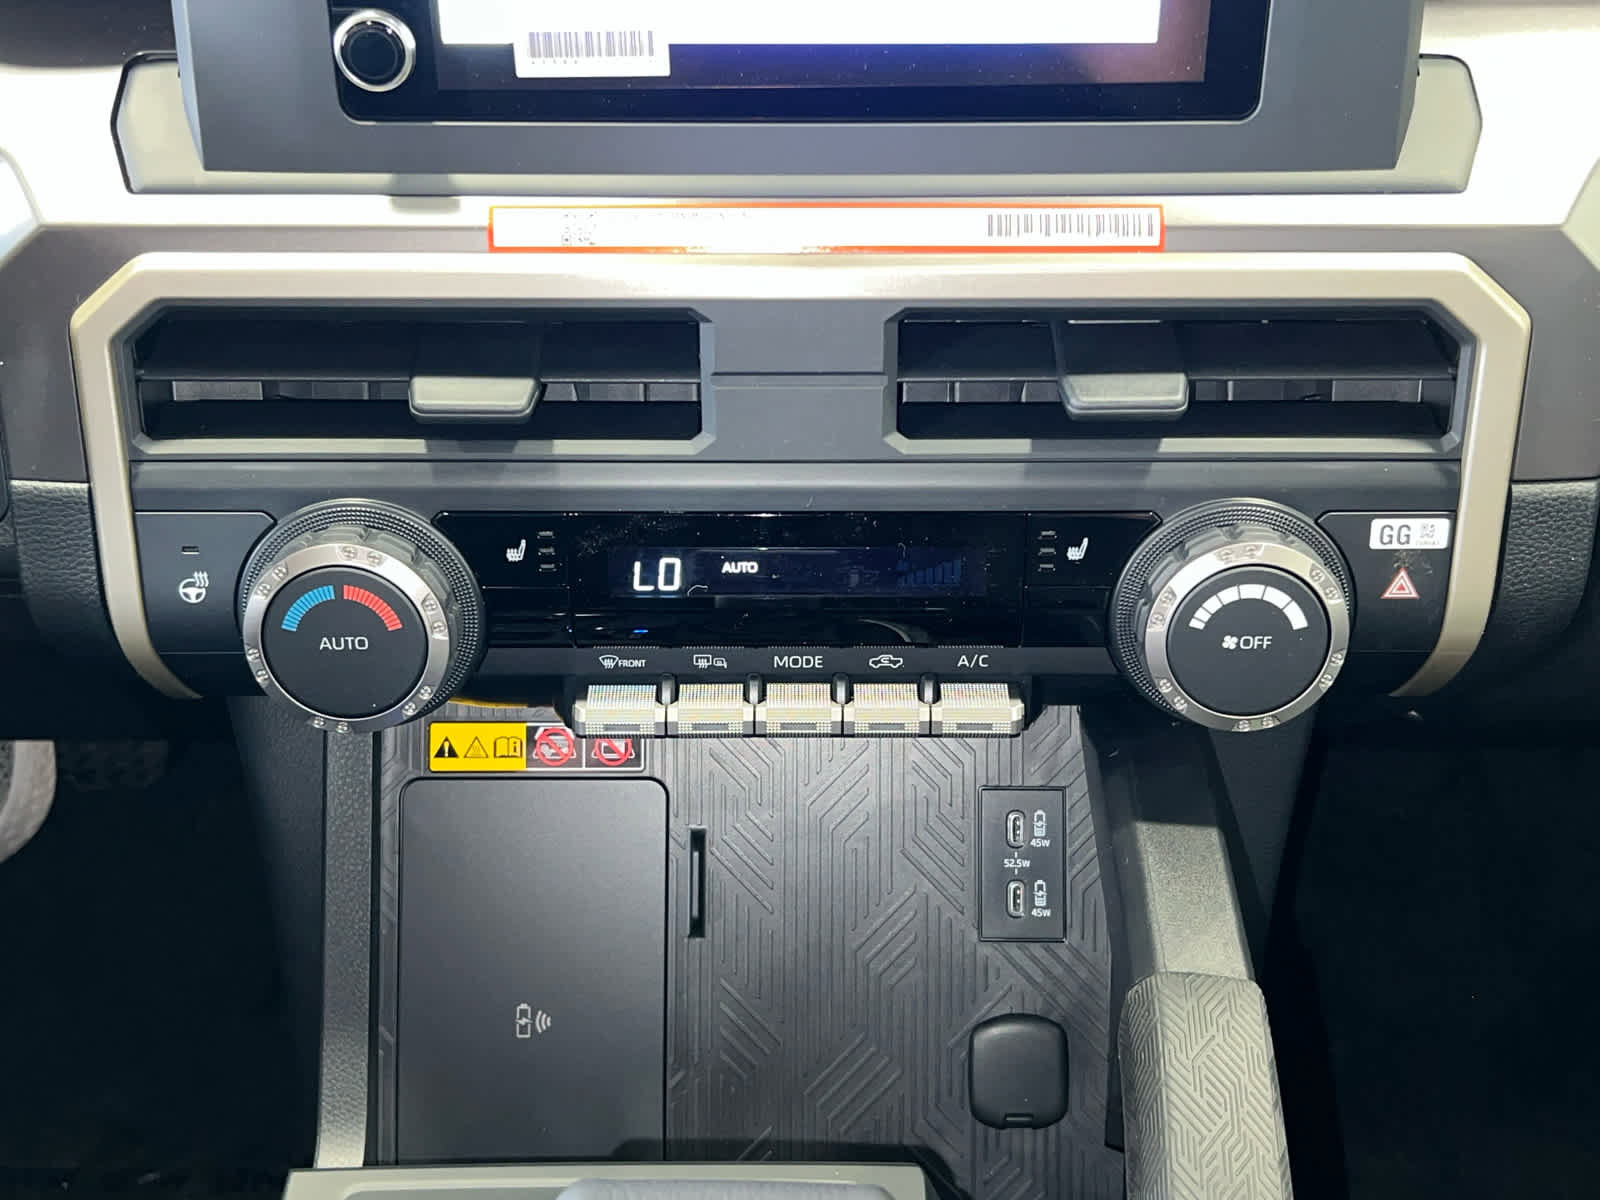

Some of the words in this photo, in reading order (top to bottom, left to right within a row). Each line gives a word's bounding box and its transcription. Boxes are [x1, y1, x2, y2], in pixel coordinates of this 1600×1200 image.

[1380, 524, 1411, 545] GG
[721, 561, 758, 574] AUTO
[319, 636, 369, 650] AUTO
[1239, 635, 1273, 649] OFF
[618, 659, 646, 667] FRONT
[773, 655, 824, 669] MODE
[957, 655, 989, 667] A/C
[1030, 838, 1050, 847] 45W
[1003, 858, 1030, 868] 52.5W
[1031, 907, 1051, 917] 45W
